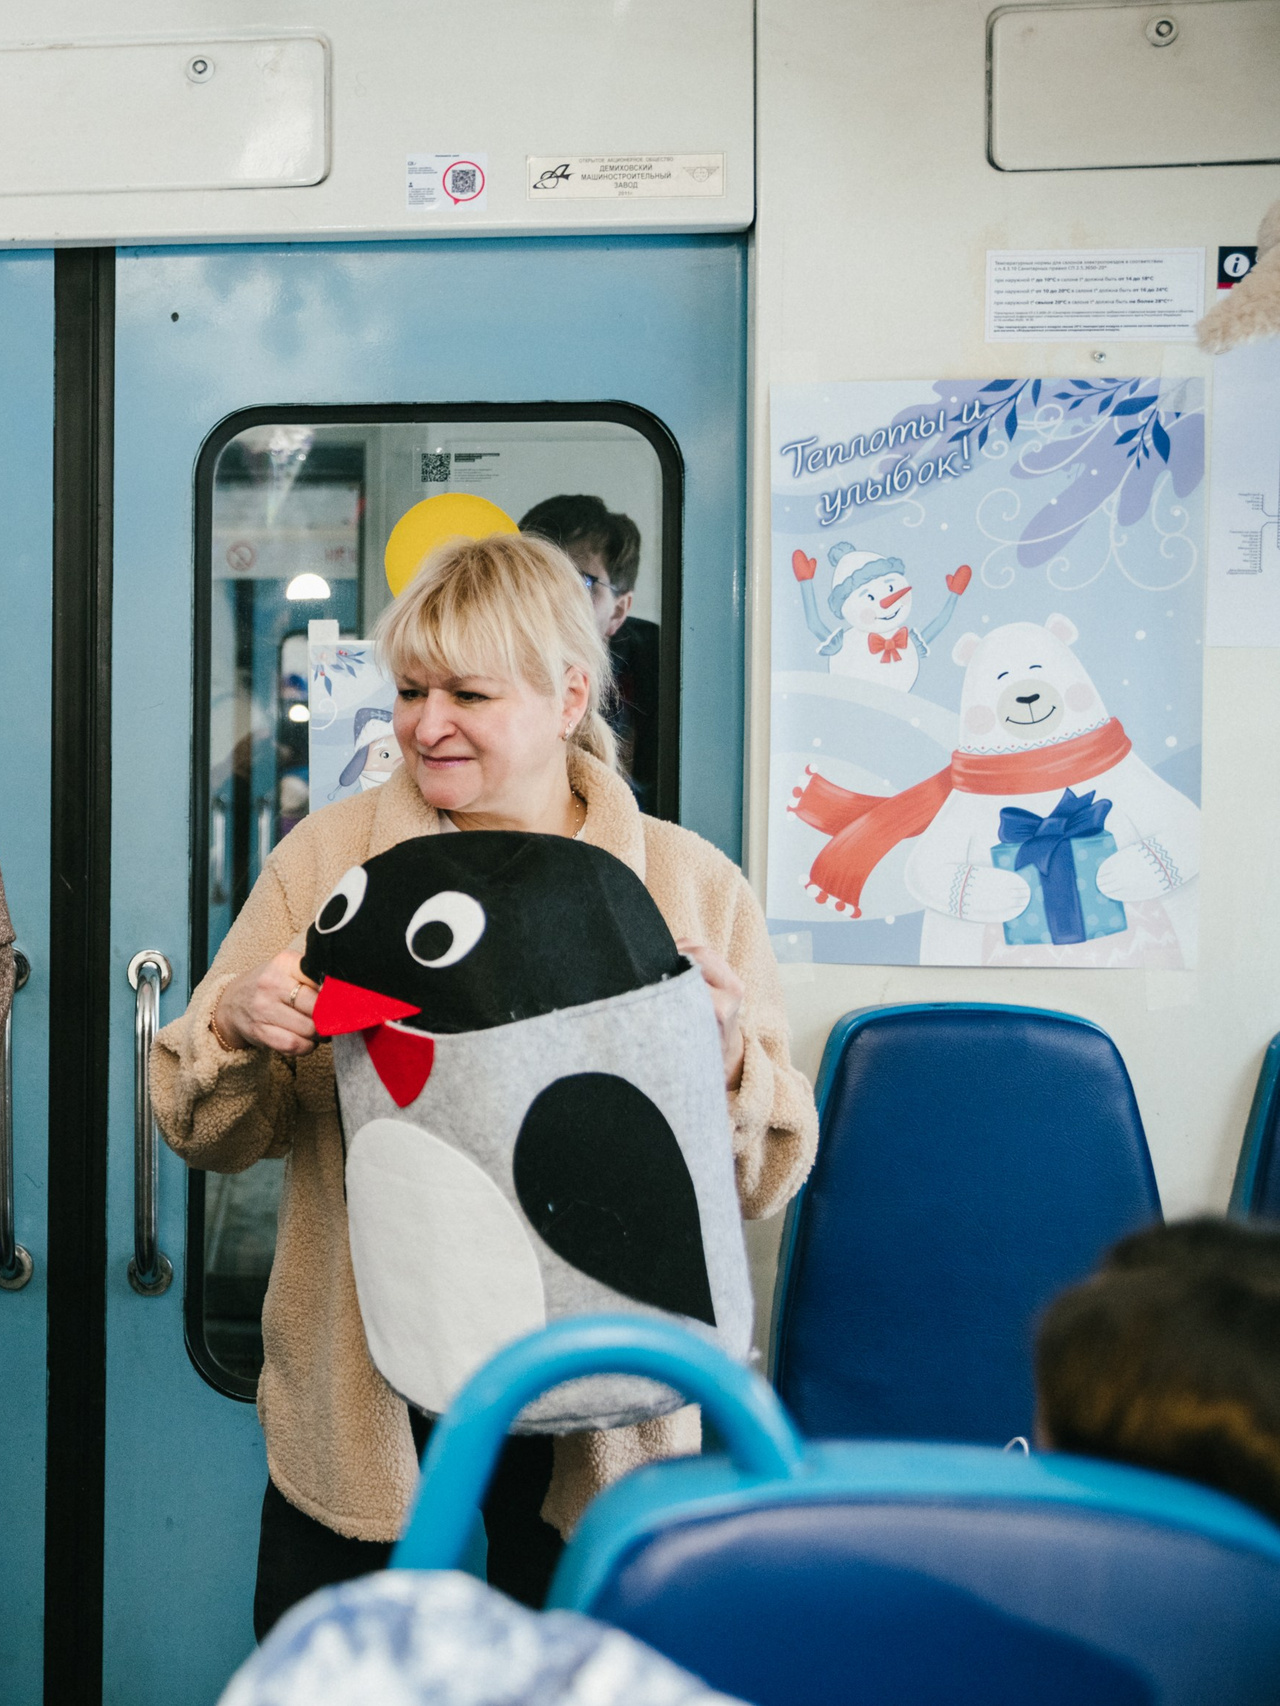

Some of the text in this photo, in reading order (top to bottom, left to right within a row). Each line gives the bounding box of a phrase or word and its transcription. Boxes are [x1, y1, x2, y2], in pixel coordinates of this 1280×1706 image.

[599, 164, 653, 172] ДЕМИХОВСКИЙ
[581, 172, 671, 181] МАШИНОСТРОИТЕЛЬНЫЙ
[614, 181, 639, 189] ЗАВОД
[781, 398, 986, 479] Теплоты и
[820, 434, 973, 527] улыбок!
